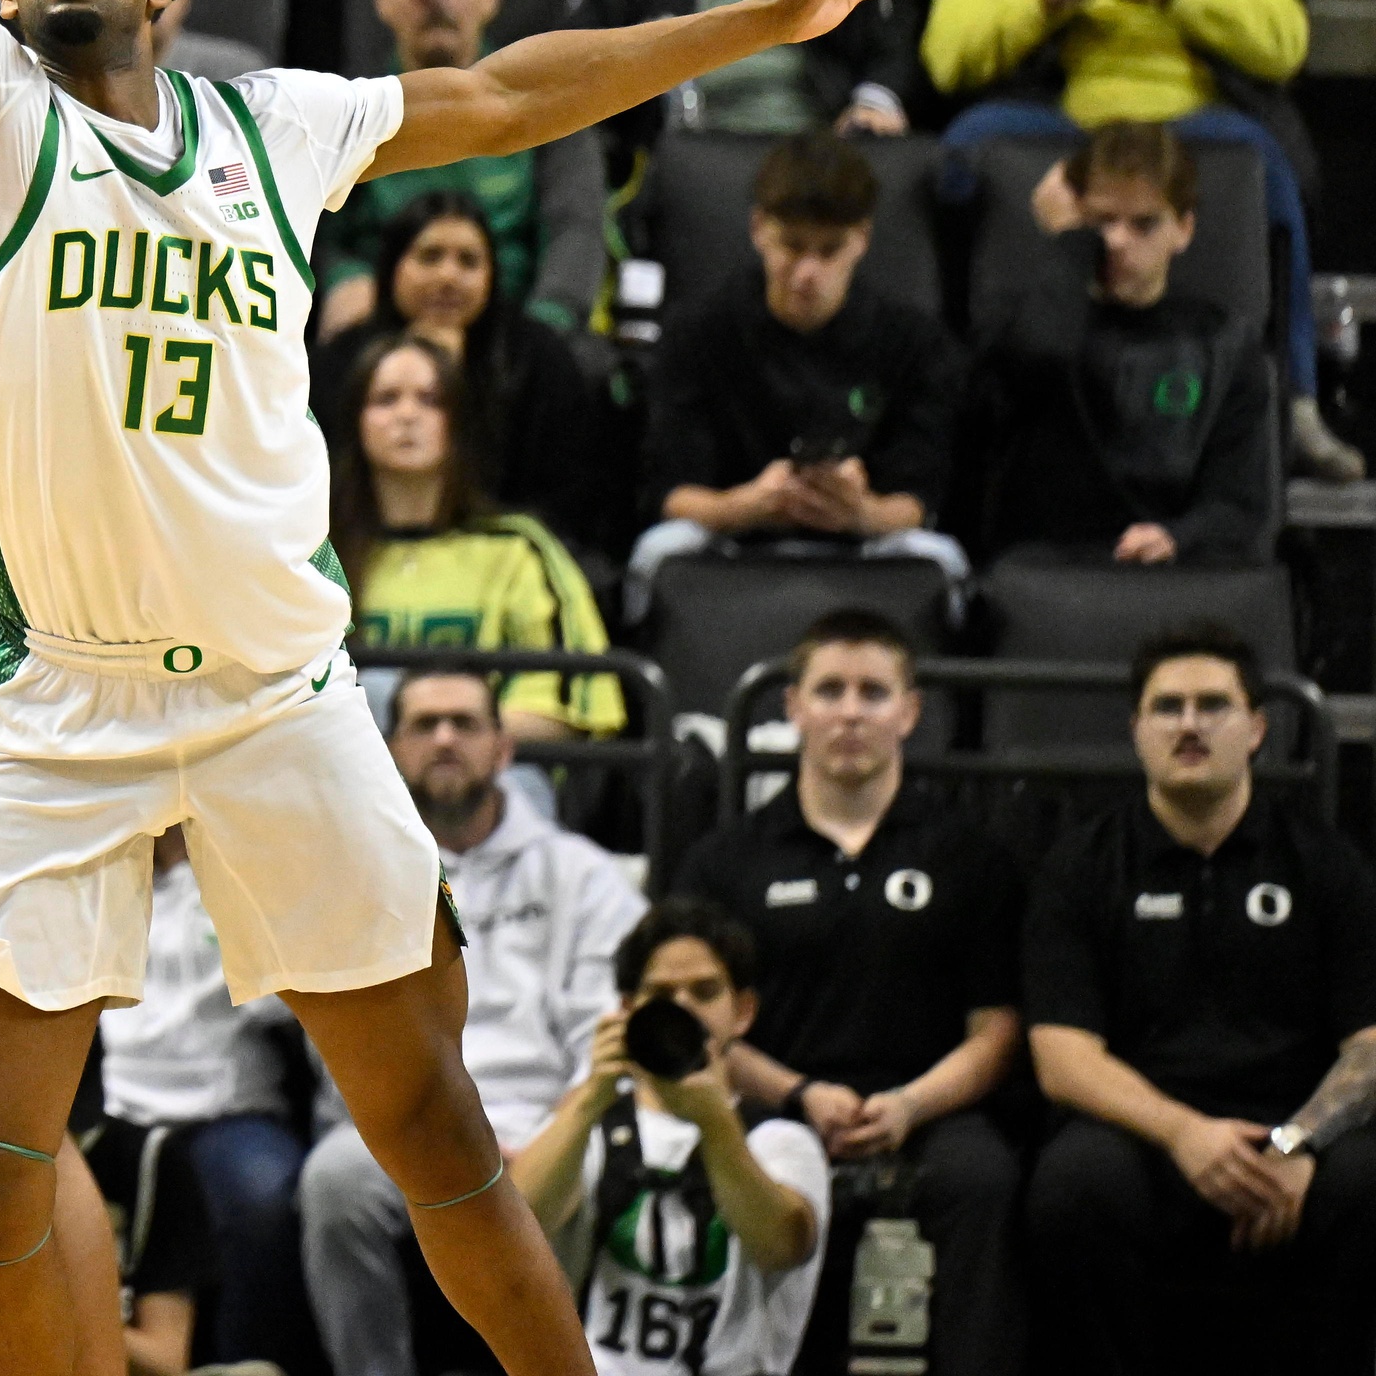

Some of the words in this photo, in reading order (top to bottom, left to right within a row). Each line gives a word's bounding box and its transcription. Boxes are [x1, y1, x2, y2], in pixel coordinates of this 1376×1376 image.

[46, 226, 279, 334] DUCKS
[120, 331, 216, 436] 13
[162, 644, 203, 674] O
[884, 868, 933, 911] O
[1245, 882, 1292, 926] O
